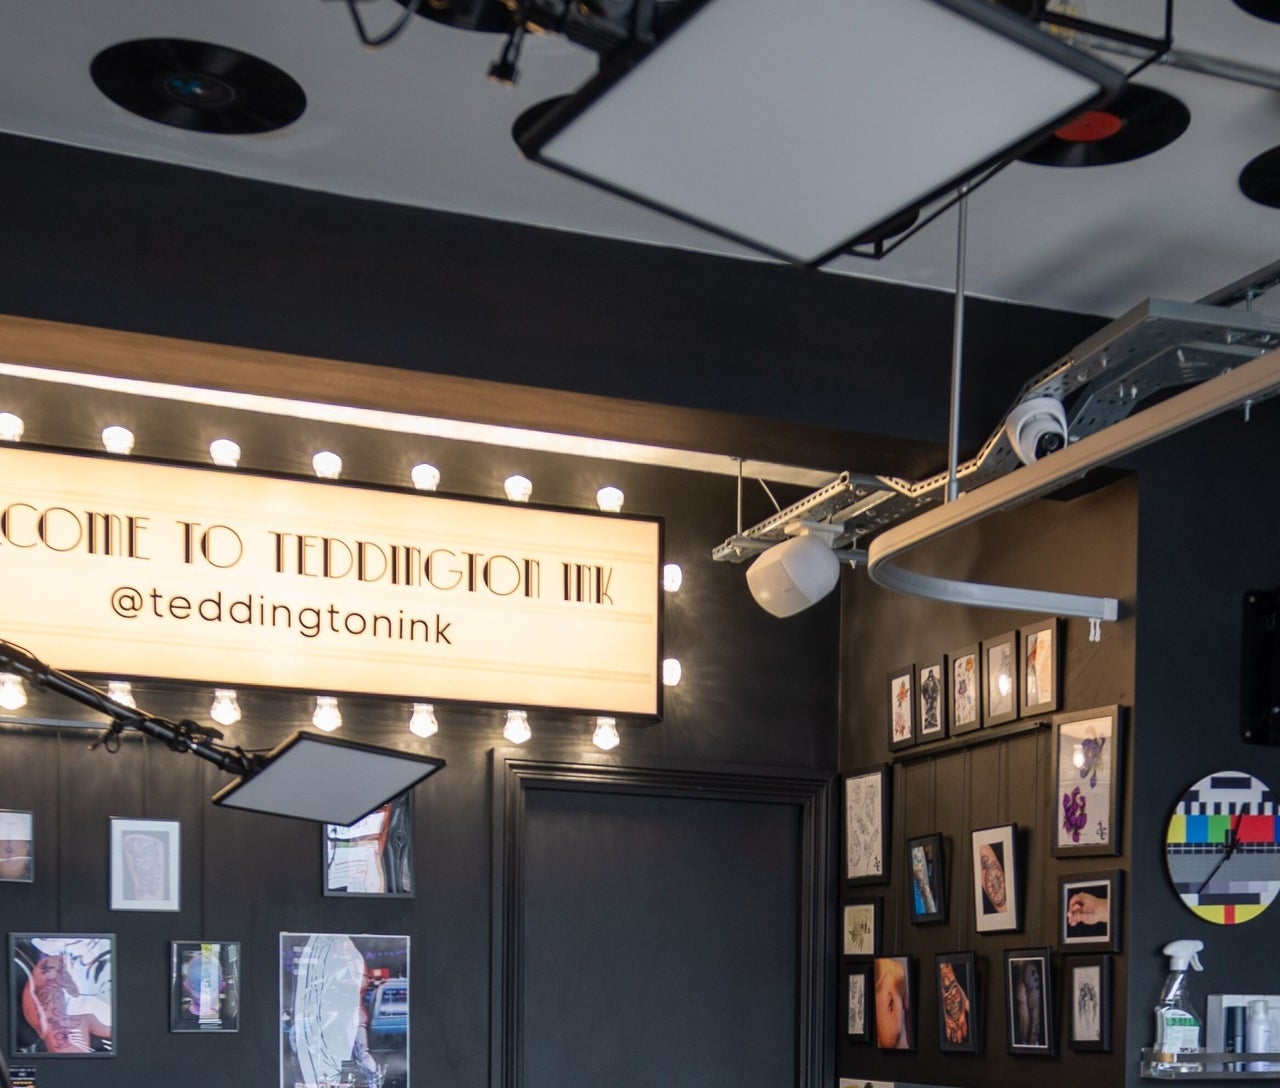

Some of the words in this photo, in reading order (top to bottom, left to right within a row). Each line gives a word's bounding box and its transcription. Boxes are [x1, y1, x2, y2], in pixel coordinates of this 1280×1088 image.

[176, 520, 243, 569] TO
[267, 530, 541, 600] TEDDINGTON
[561, 561, 615, 606] INK
[111, 586, 453, 646] @teddingtonink
